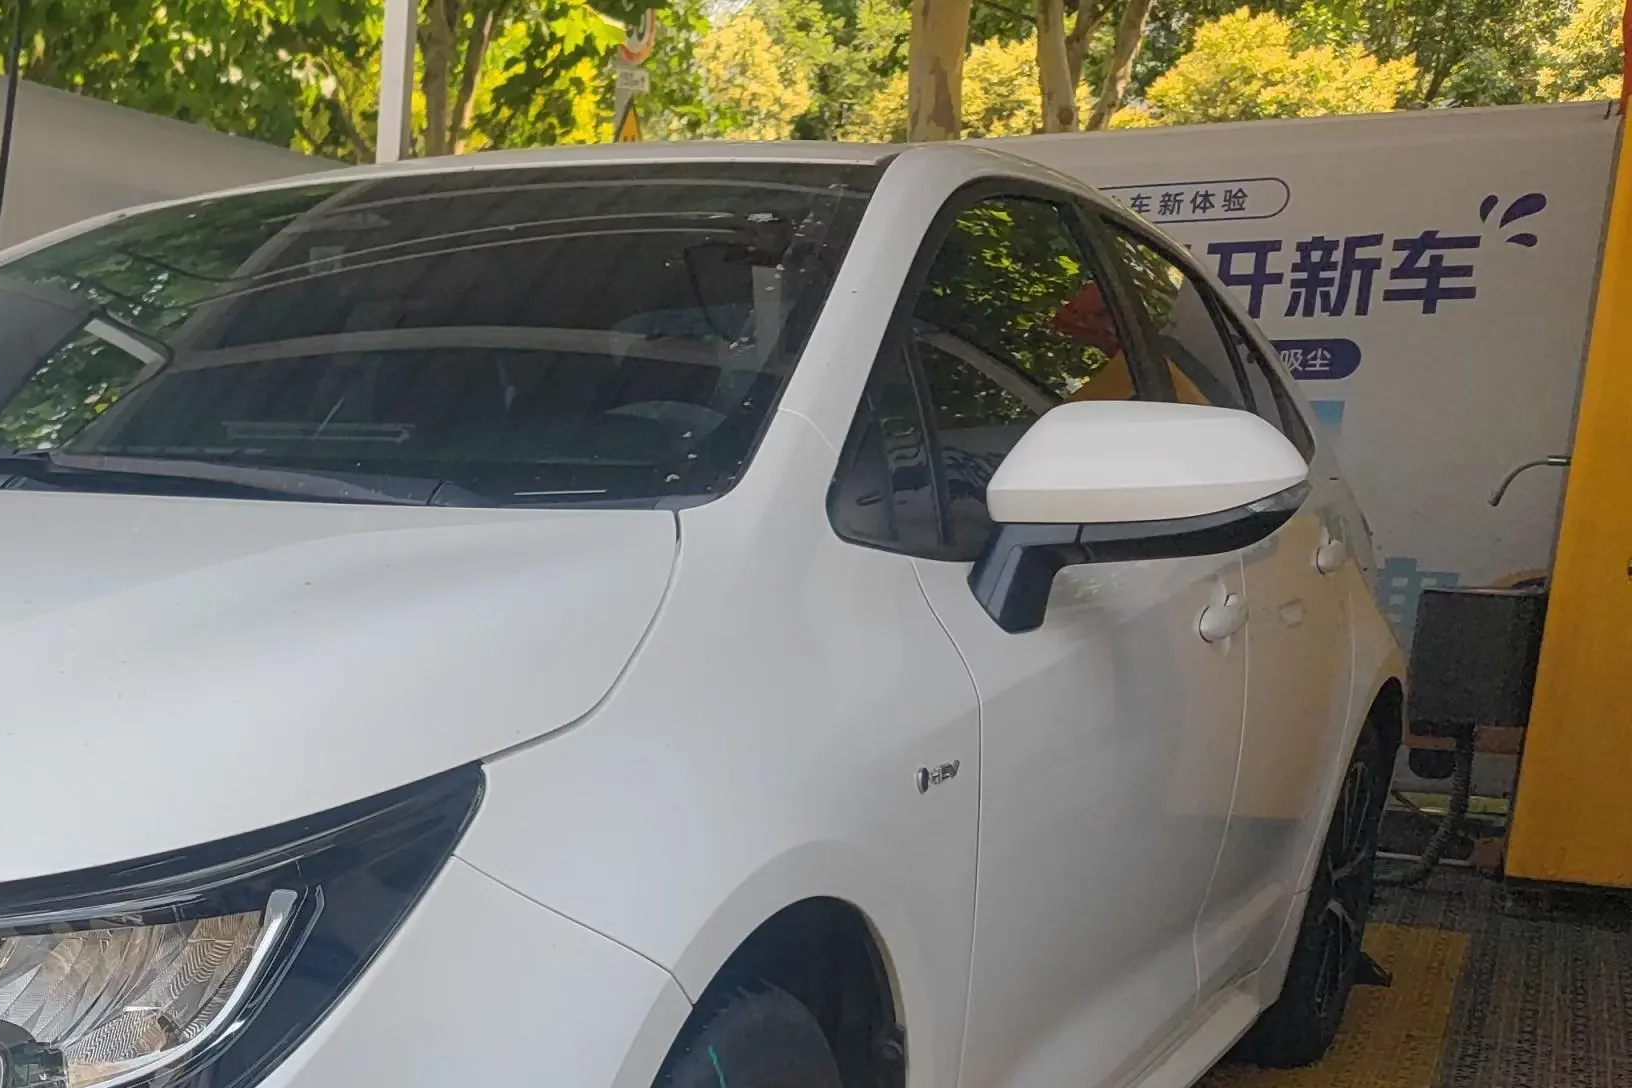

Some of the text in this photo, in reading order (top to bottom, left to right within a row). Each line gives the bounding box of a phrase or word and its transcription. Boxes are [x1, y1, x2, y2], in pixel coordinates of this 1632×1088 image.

[1112, 187, 1249, 216] 车新体验
[1184, 230, 1481, 319] 开新车
[1280, 348, 1332, 372] 吸尘
